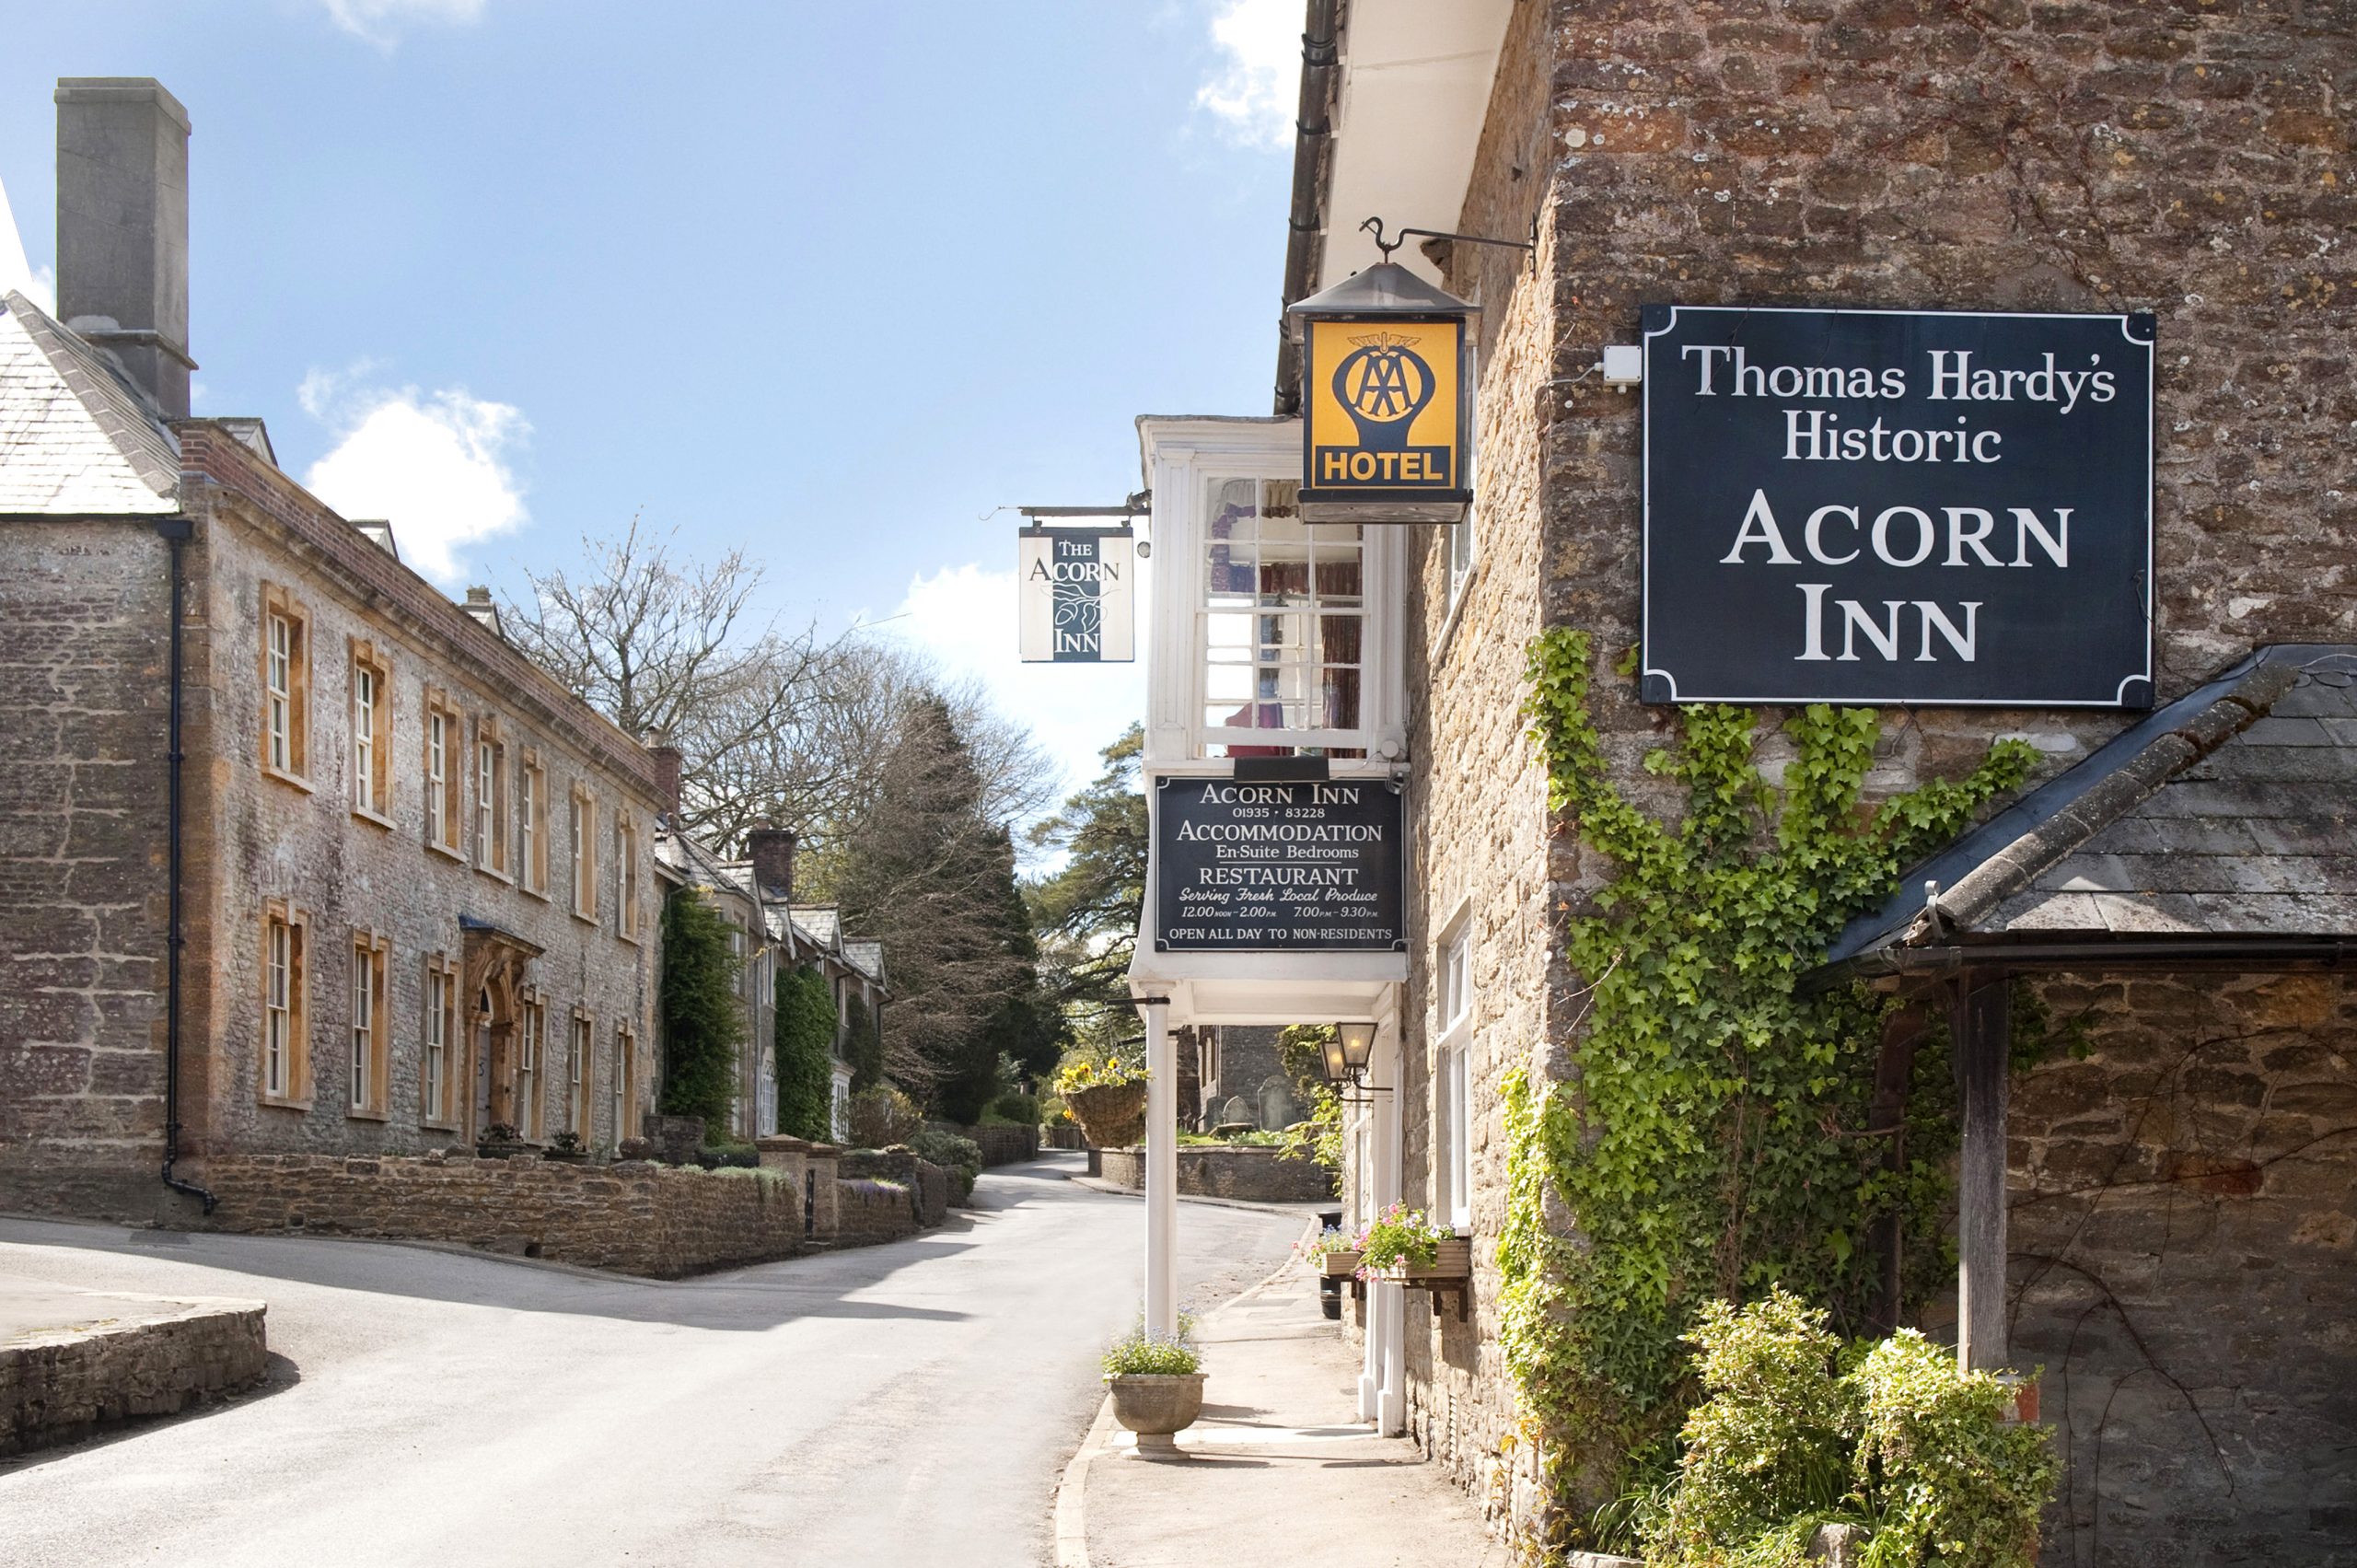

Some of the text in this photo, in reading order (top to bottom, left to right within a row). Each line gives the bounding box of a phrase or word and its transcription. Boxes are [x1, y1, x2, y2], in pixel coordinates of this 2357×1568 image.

[1681, 344, 2115, 414] Thomas Hardy's
[1782, 409, 2002, 463] Historic
[1324, 451, 1444, 481] HOTEL
[1719, 488, 2074, 568] ACORN
[1059, 540, 1093, 556] THE
[1028, 556, 1120, 582] ACORN
[1794, 583, 1983, 662] INN
[1054, 628, 1100, 653] INN
[1199, 784, 1360, 805] ACORN INN
[1232, 807, 1326, 819] 01935 83228
[1176, 819, 1383, 842] ACCOMMODATION
[1215, 844, 1359, 858] En-Suite Bedrooms
[1199, 867, 1359, 886] RESTAURANT
[1178, 887, 1378, 904] Serving Fresh Local Produce
[1169, 928, 1392, 940] OPEN ALL DAY TO NON-RESIDENTS
